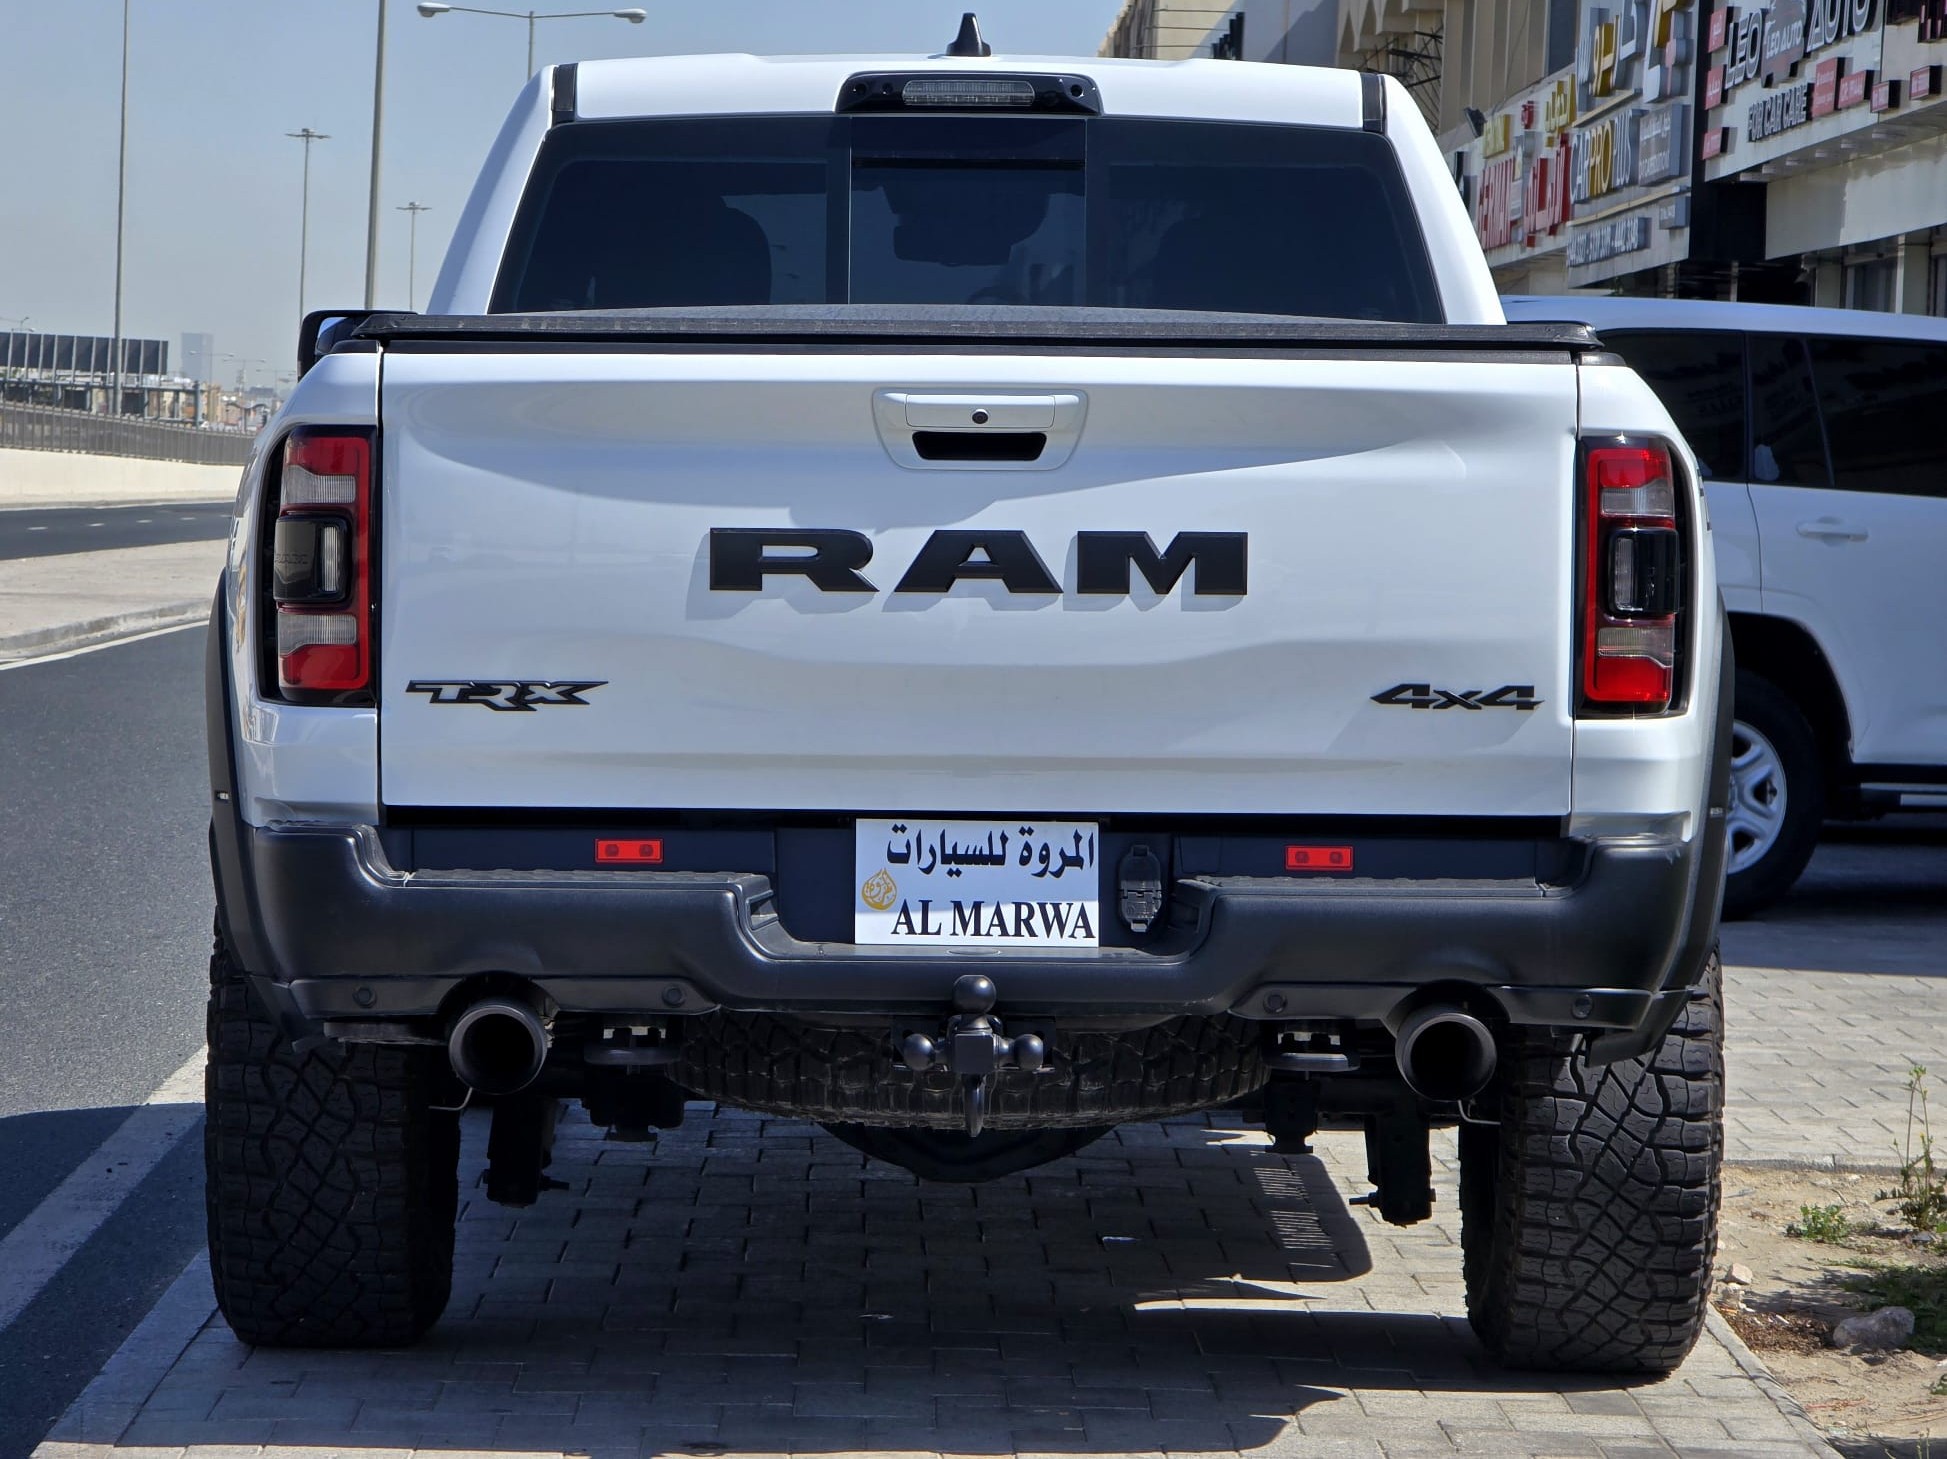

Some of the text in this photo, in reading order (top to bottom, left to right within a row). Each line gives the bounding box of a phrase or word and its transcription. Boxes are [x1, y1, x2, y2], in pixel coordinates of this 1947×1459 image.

[1725, 9, 1763, 89] LEO
[1766, 20, 1803, 60] LEO AUTO
[1748, 102, 1763, 142] FOR
[1764, 94, 1782, 134] CAR
[1783, 84, 1807, 127] CARE
[1613, 109, 1633, 187] PLUS
[709, 527, 1248, 595] RAM
[406, 680, 608, 711] TRX
[1369, 683, 1545, 710] 4x4
[886, 823, 1094, 879] المروة للسيارات
[891, 899, 1096, 939] AL MARWA
